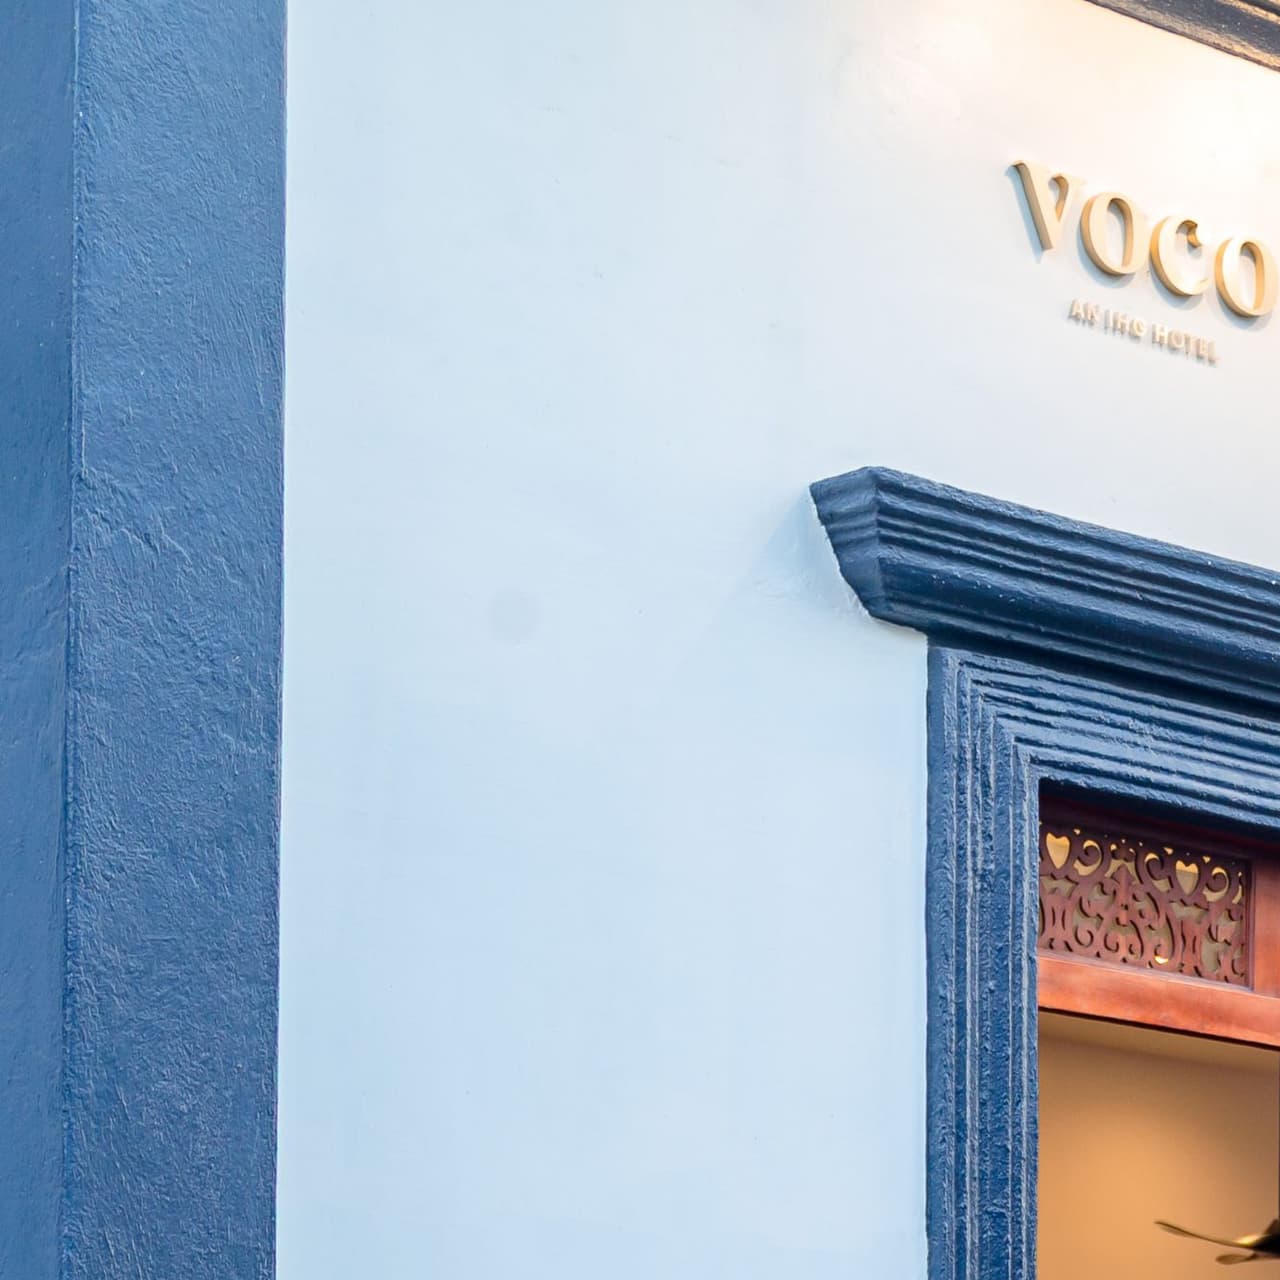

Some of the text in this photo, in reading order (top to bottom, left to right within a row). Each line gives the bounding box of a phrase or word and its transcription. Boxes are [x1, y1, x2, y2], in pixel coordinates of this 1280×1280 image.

[1069, 299, 1218, 365] AN IHG HOTEL
